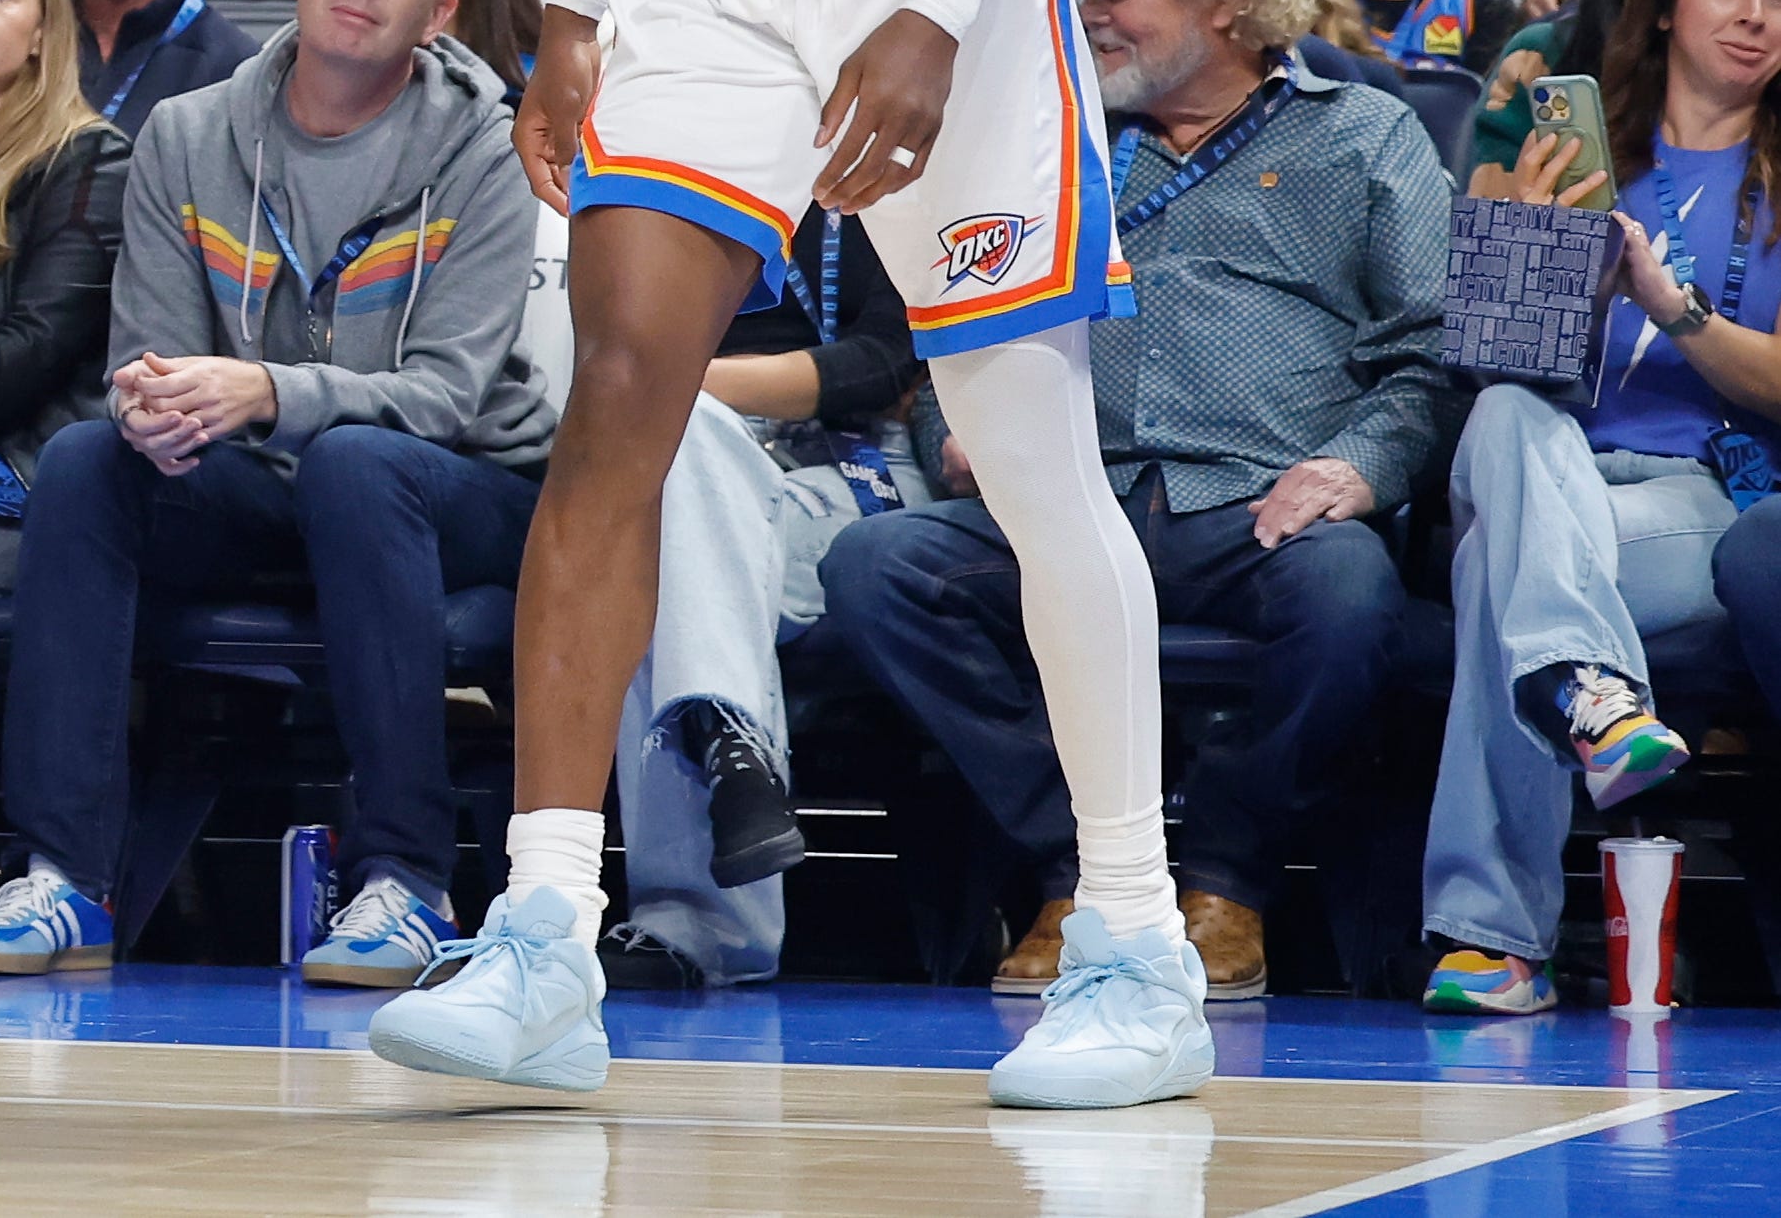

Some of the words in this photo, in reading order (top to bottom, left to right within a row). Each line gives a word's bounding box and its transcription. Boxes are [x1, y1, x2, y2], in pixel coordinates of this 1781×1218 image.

[947, 222, 1007, 280] OKC
[1539, 268, 1587, 296] CITY
[1493, 340, 1540, 368] CITY
